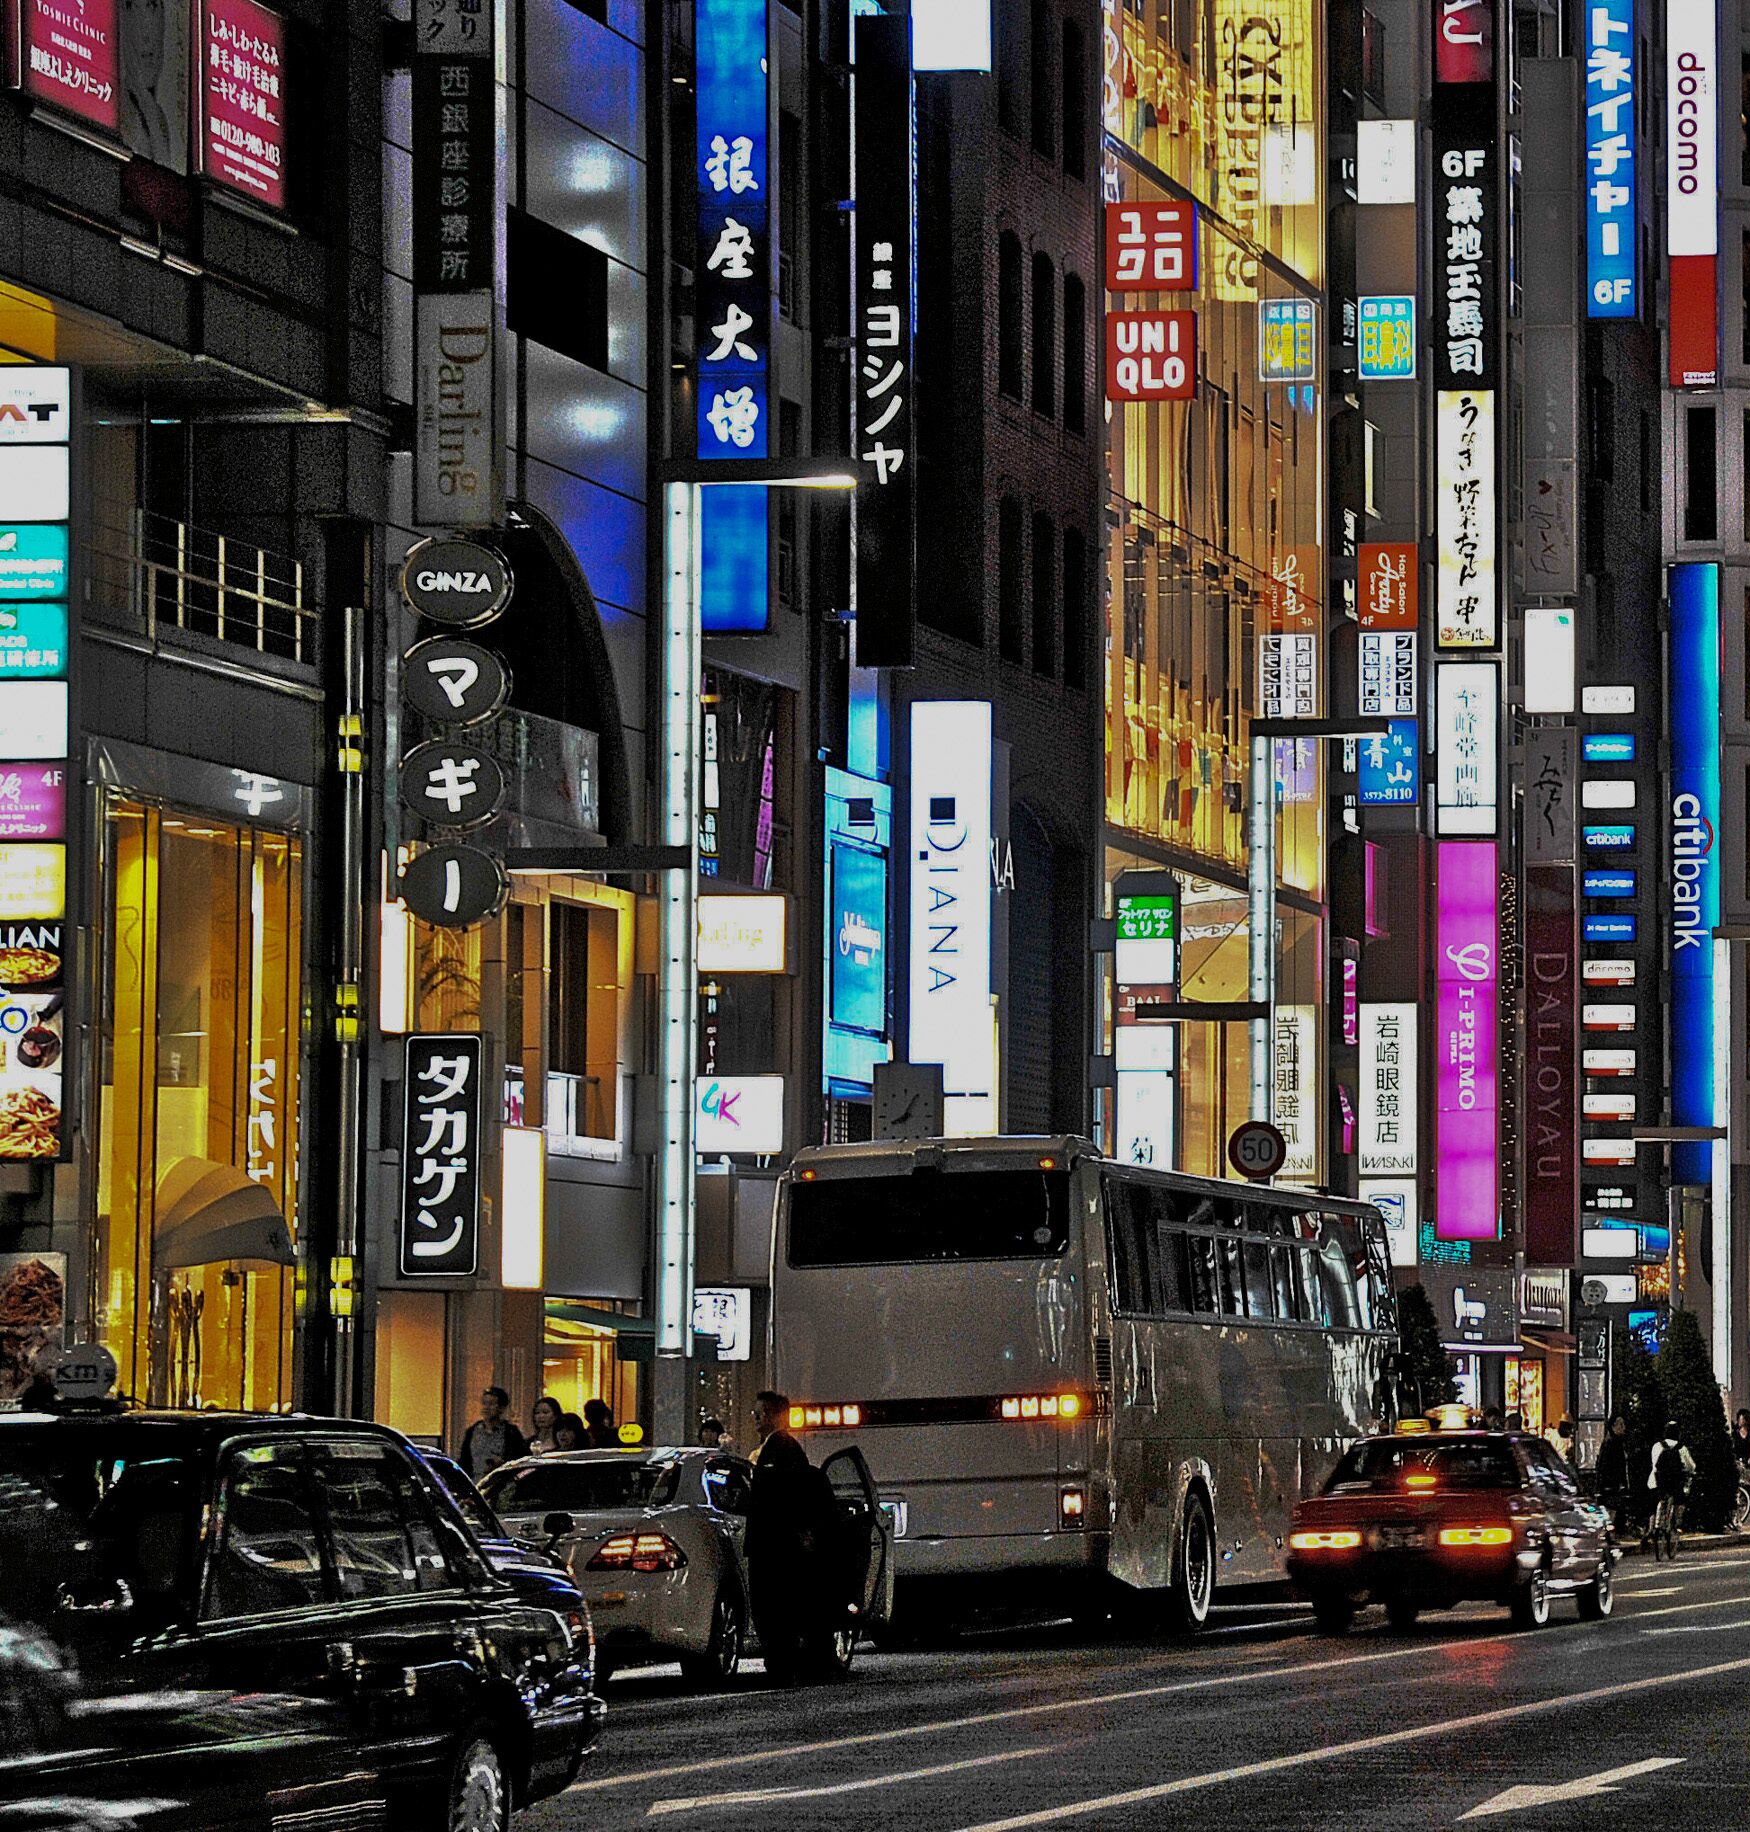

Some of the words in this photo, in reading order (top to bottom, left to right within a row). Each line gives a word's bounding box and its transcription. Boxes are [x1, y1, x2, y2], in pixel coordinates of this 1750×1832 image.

[73, 17, 106, 45] CLINIC
[1441, 149, 1486, 178] 6F
[1587, 7, 1632, 256] トネイチャー
[1677, 52, 1706, 195] docomo
[1593, 279, 1632, 305] 6F
[1116, 320, 1179, 355] UNI
[1116, 356, 1186, 394] QLO
[438, 325, 490, 497] Darling
[862, 304, 905, 485] ヨシノヤ
[416, 571, 492, 594] GINZA
[41, 770, 63, 787] 4F
[424, 656, 480, 913] マギー
[1586, 832, 1632, 846] citibank
[1673, 792, 1710, 951] citibank
[927, 819, 967, 993] DIANA
[1122, 920, 1169, 937] セリナ
[1375, 1015, 1401, 1144] 岩崎眼鏡店
[1457, 986, 1477, 1111] I-PRIMO
[411, 1054, 472, 1257] タカゲン
[1242, 1137, 1274, 1162] 50
